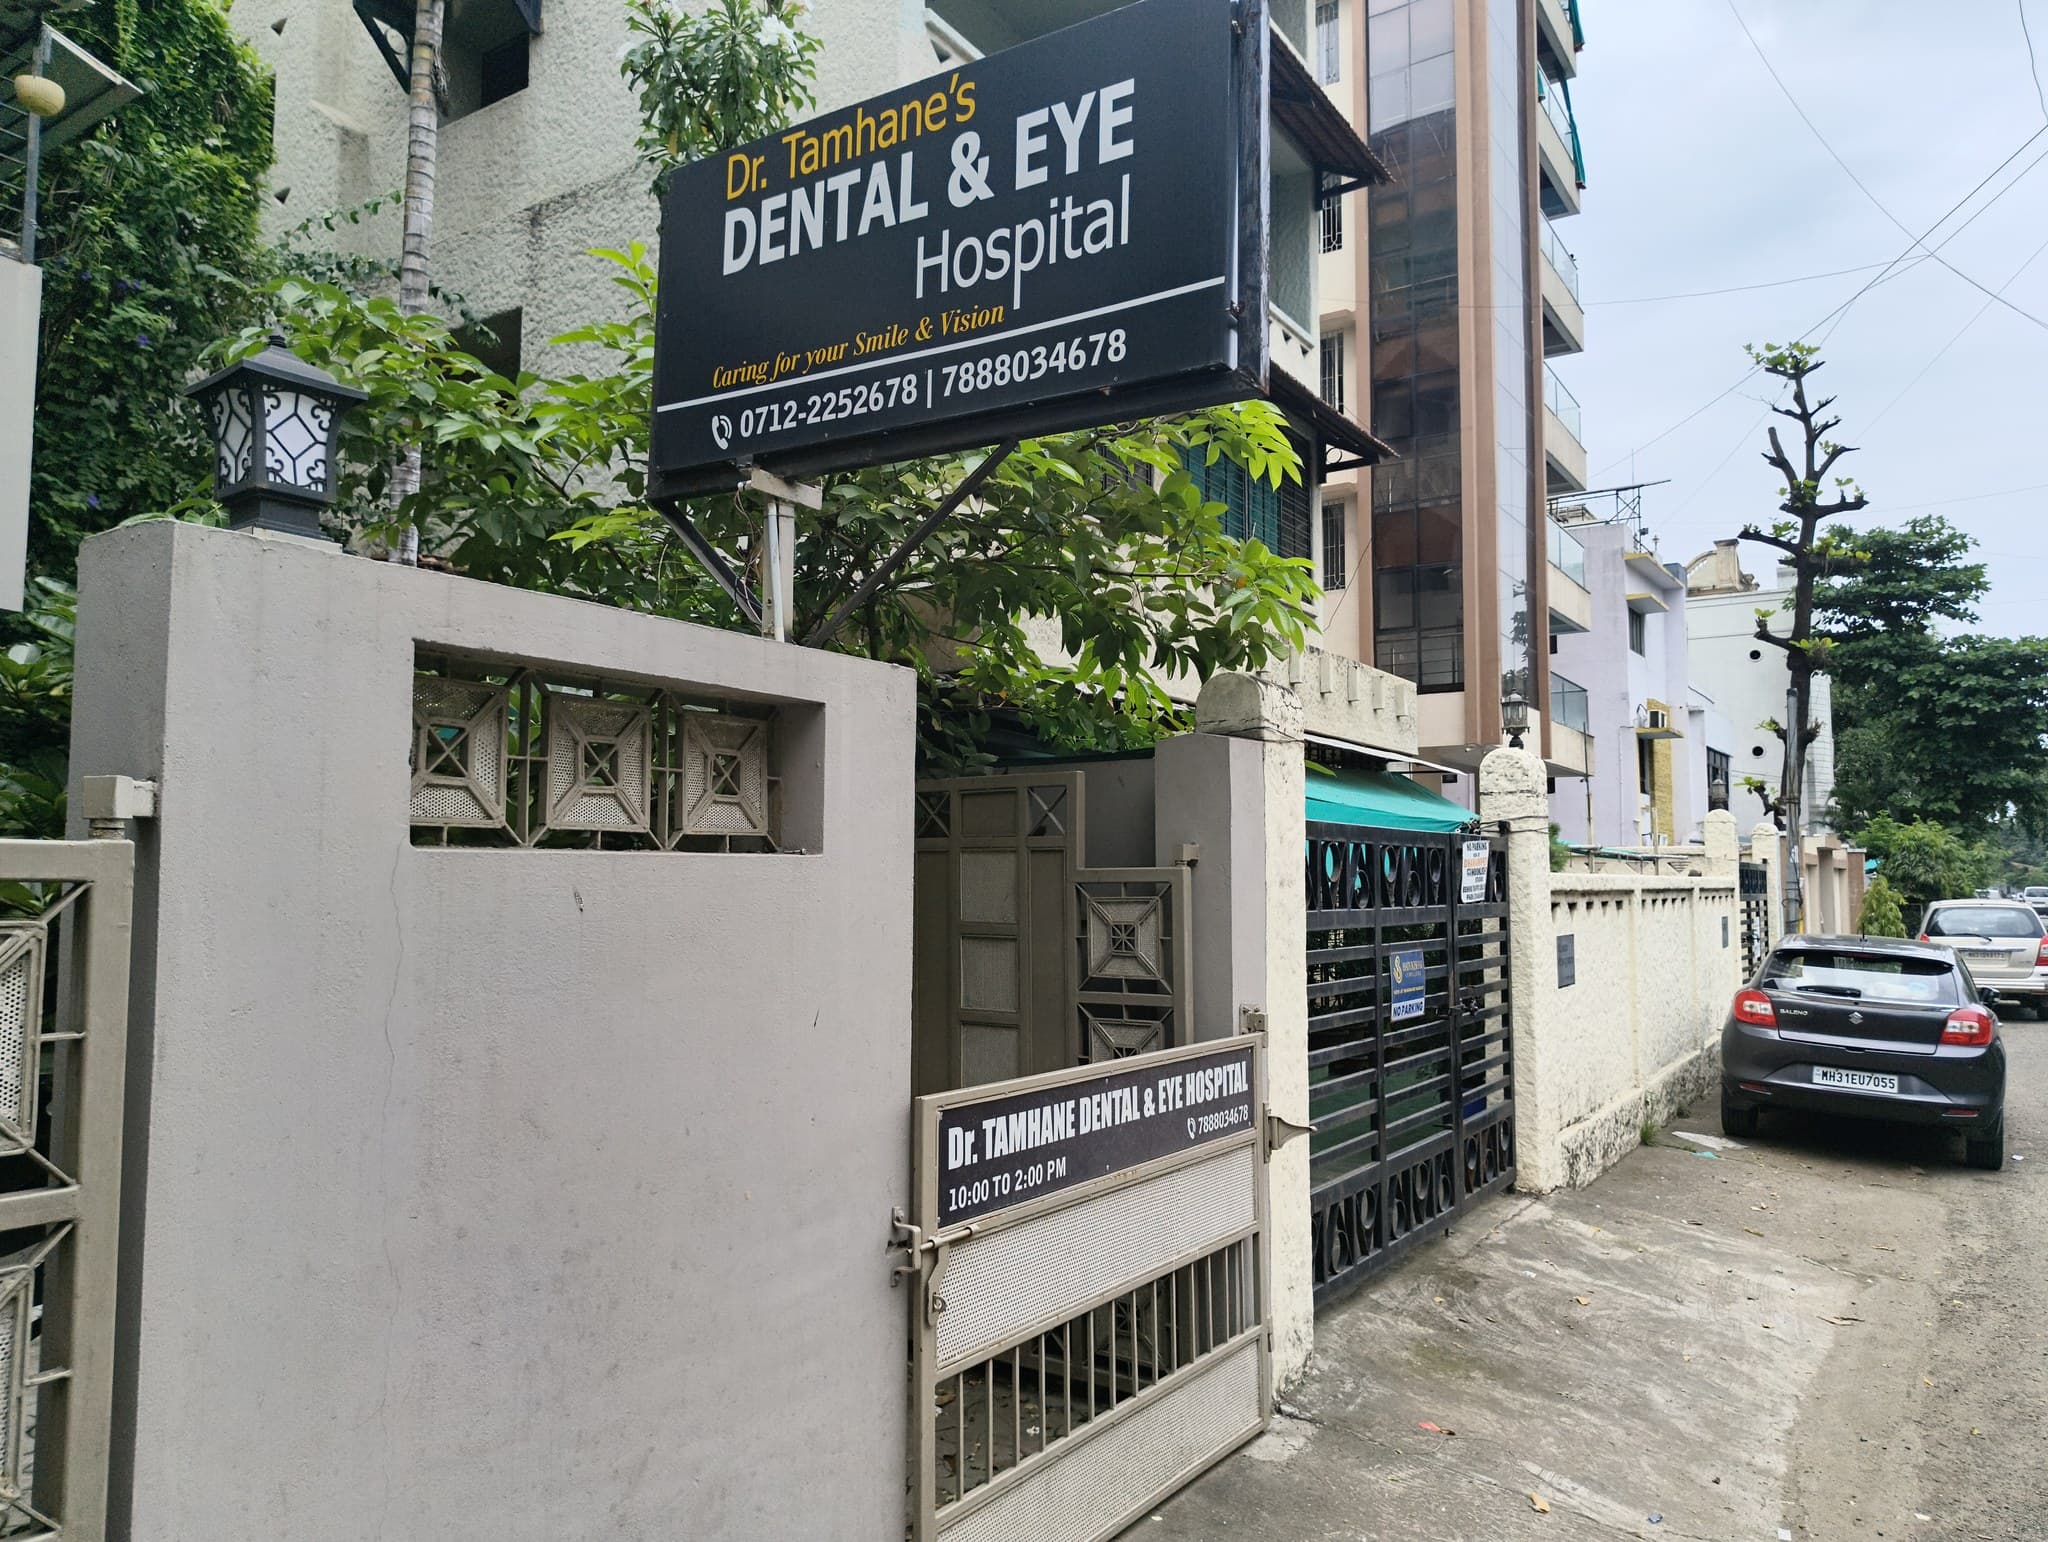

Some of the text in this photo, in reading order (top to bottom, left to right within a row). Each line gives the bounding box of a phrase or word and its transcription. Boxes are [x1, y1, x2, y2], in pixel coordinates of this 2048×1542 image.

[722, 77, 1135, 276] DENTAL & EYE
[726, 73, 976, 200] Dr. Tamhane's
[916, 173, 1130, 310] Hospital
[713, 304, 1005, 388] Caring for your Smile & Vision
[740, 373, 918, 439] 0712-2252678
[942, 328, 1128, 398] 7888034678
[1393, 1000, 1424, 1017] NO PARKING
[1779, 1008, 1809, 1016] BALENO
[947, 1061, 1249, 1170] Dr. TAMHANE DENTAL & EYE HOSPITAL
[1197, 1104, 1249, 1135] 7888034678
[1821, 1070, 1896, 1090] MH31EU7055
[948, 1156, 1067, 1212] 10:00 TO 2:00 PM
